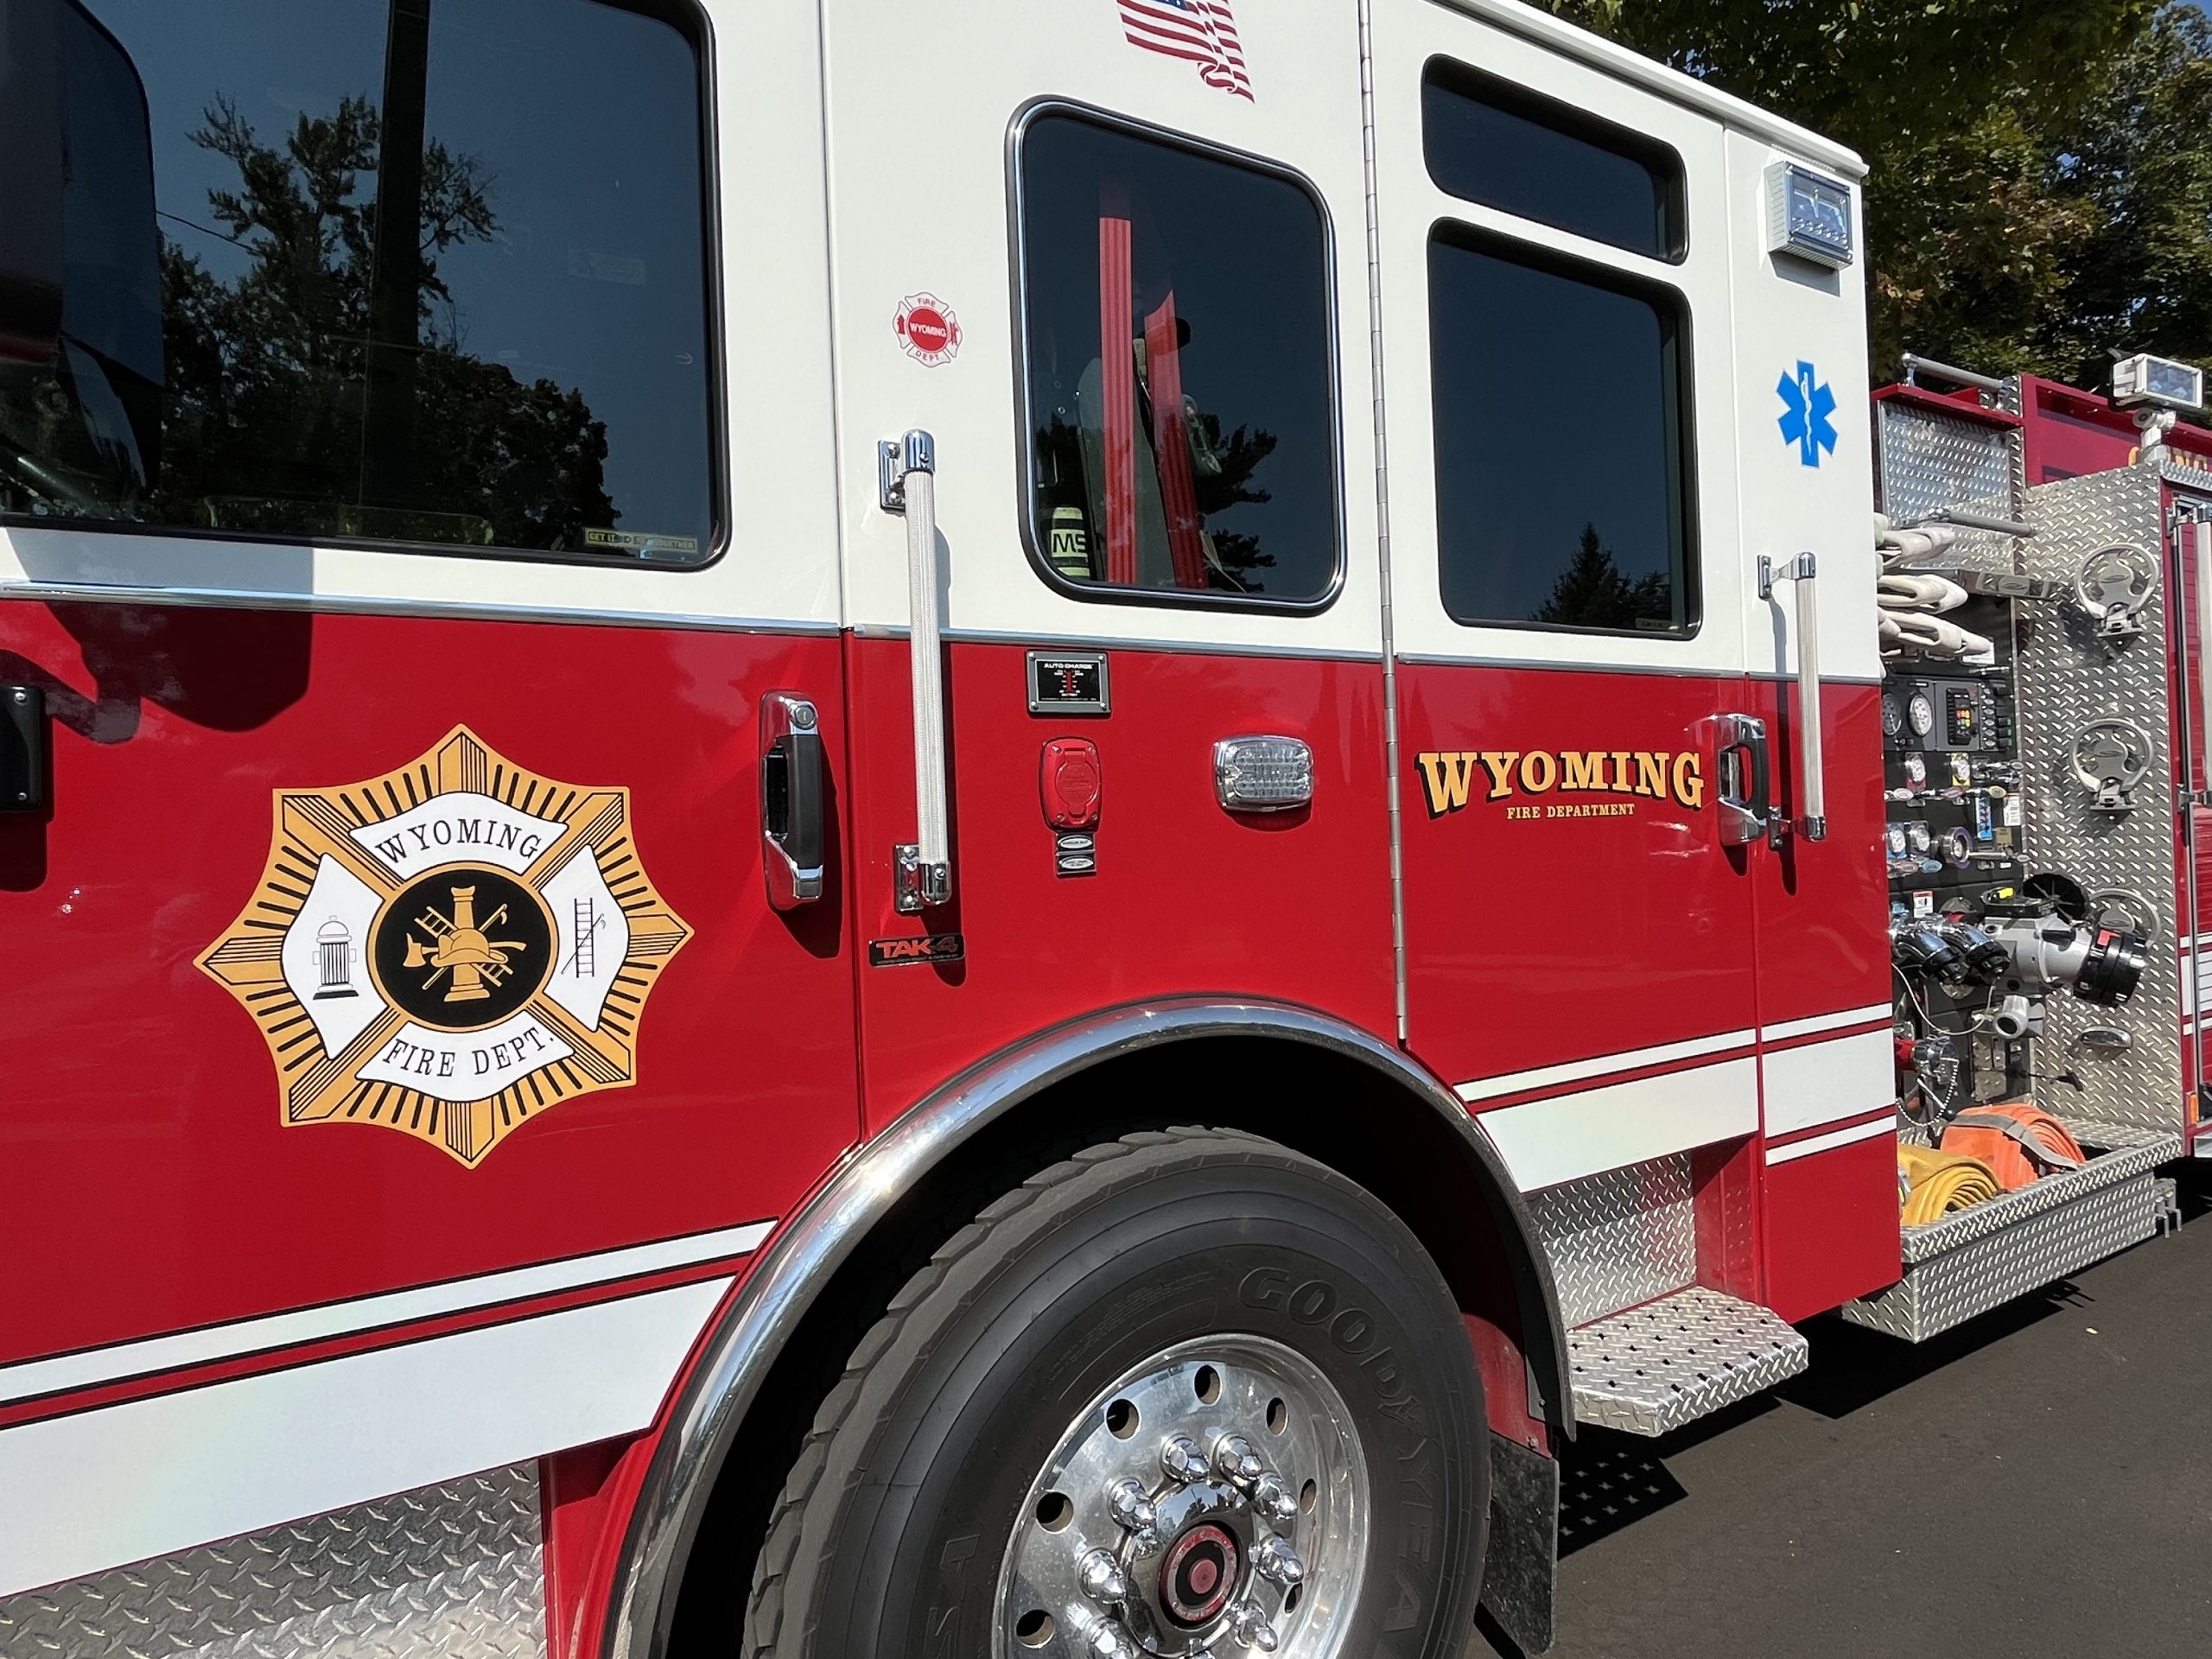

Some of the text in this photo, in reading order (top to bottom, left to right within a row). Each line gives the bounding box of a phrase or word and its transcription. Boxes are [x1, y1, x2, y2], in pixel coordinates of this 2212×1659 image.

[918, 297, 937, 308] FIRE
[910, 322, 946, 338] WYOMING
[915, 350, 939, 361] DEPT
[589, 531, 606, 542] GET
[1416, 750, 1705, 817] WYOMING
[1506, 803, 1636, 820] FIRE DEPARTMENT
[374, 818, 543, 864] WYOMING
[382, 1038, 456, 1077] FIRE
[1237, 1265, 1436, 1659] GOODYEA
